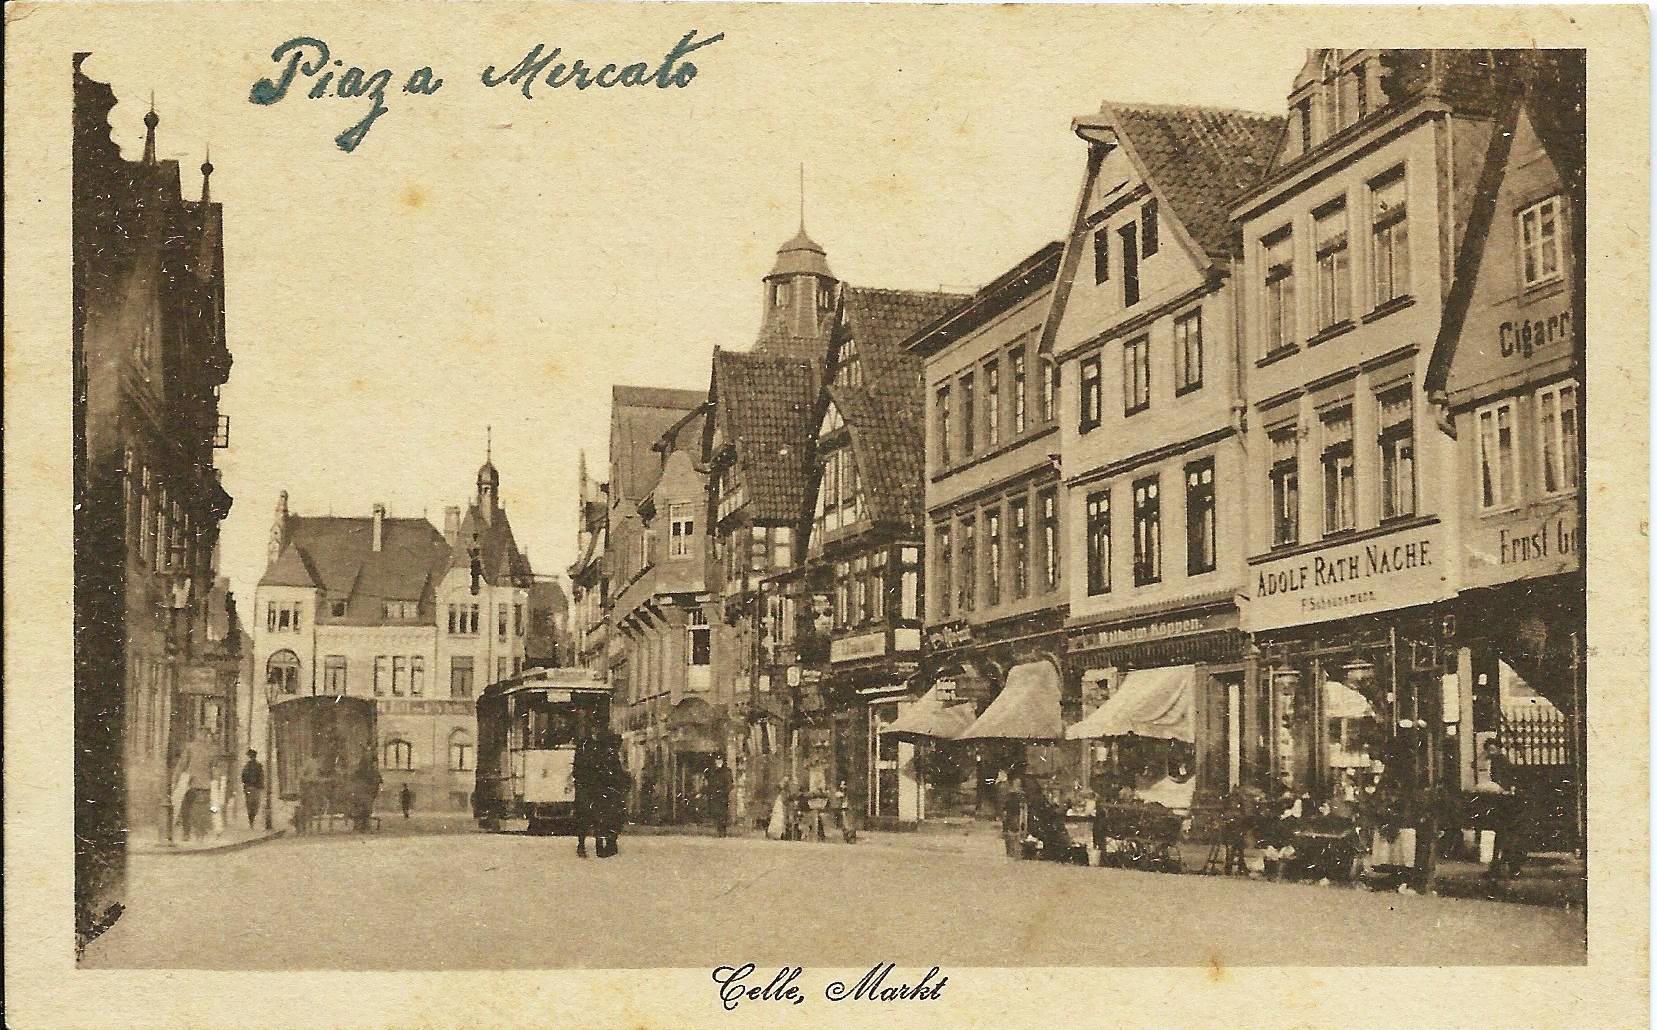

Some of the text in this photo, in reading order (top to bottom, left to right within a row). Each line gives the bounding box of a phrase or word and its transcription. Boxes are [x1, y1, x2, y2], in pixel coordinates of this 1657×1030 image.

[481, 30, 725, 99] Mercato
[1500, 520, 1547, 564] Ernst
[1257, 566, 1308, 598] ADOLF
[1314, 555, 1359, 587] RATH
